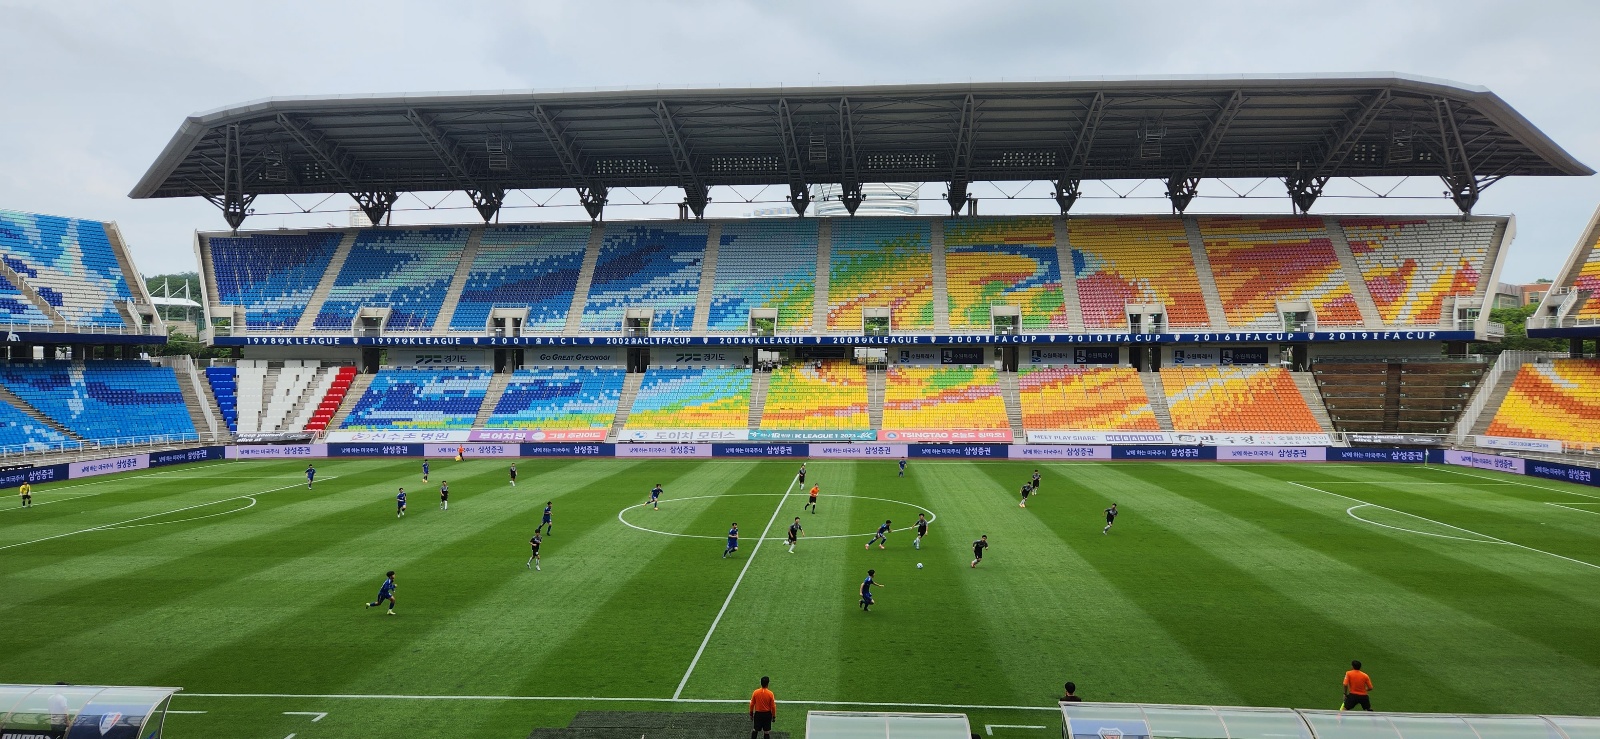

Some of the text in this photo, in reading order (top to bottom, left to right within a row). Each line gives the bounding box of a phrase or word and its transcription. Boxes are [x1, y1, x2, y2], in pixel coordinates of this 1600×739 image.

[833, 336, 860, 344] 2008
[877, 336, 919, 344] LEAGUE
[948, 335, 981, 343] 2009
[1068, 334, 1103, 342] 2010
[1194, 333, 1231, 341] 2016
[1329, 332, 1368, 340] 2019
[246, 337, 276, 345] 1998
[296, 337, 340, 345] LEAGUE
[371, 337, 400, 345] 1999
[418, 337, 461, 345] LEAGUE
[491, 337, 529, 345] 2001
[606, 337, 629, 345] 2002
[444, 354, 467, 362] 경기도
[654, 431, 736, 440] 도이치 모터스
[283, 446, 311, 455] 삼성증권
[382, 445, 408, 455] 삼성증권
[478, 445, 504, 454] 삼성증권
[573, 445, 599, 454] 삼성증권
[669, 445, 696, 454] 삼성증권
[766, 445, 793, 455] 삼성증권
[864, 446, 891, 455] 삼성증권
[964, 446, 991, 456] 삼성증권
[1066, 447, 1094, 457] 삼성증권
[1170, 448, 1199, 457] 삼성증권
[1277, 448, 1307, 458] 삼성증권
[1390, 451, 1423, 461] 삼성증권
[116, 458, 137, 469] 삼성증권
[1494, 458, 1513, 469] 삼성증권
[29, 469, 54, 482] 삼성증권
[1567, 469, 1591, 482] 삼성증권
